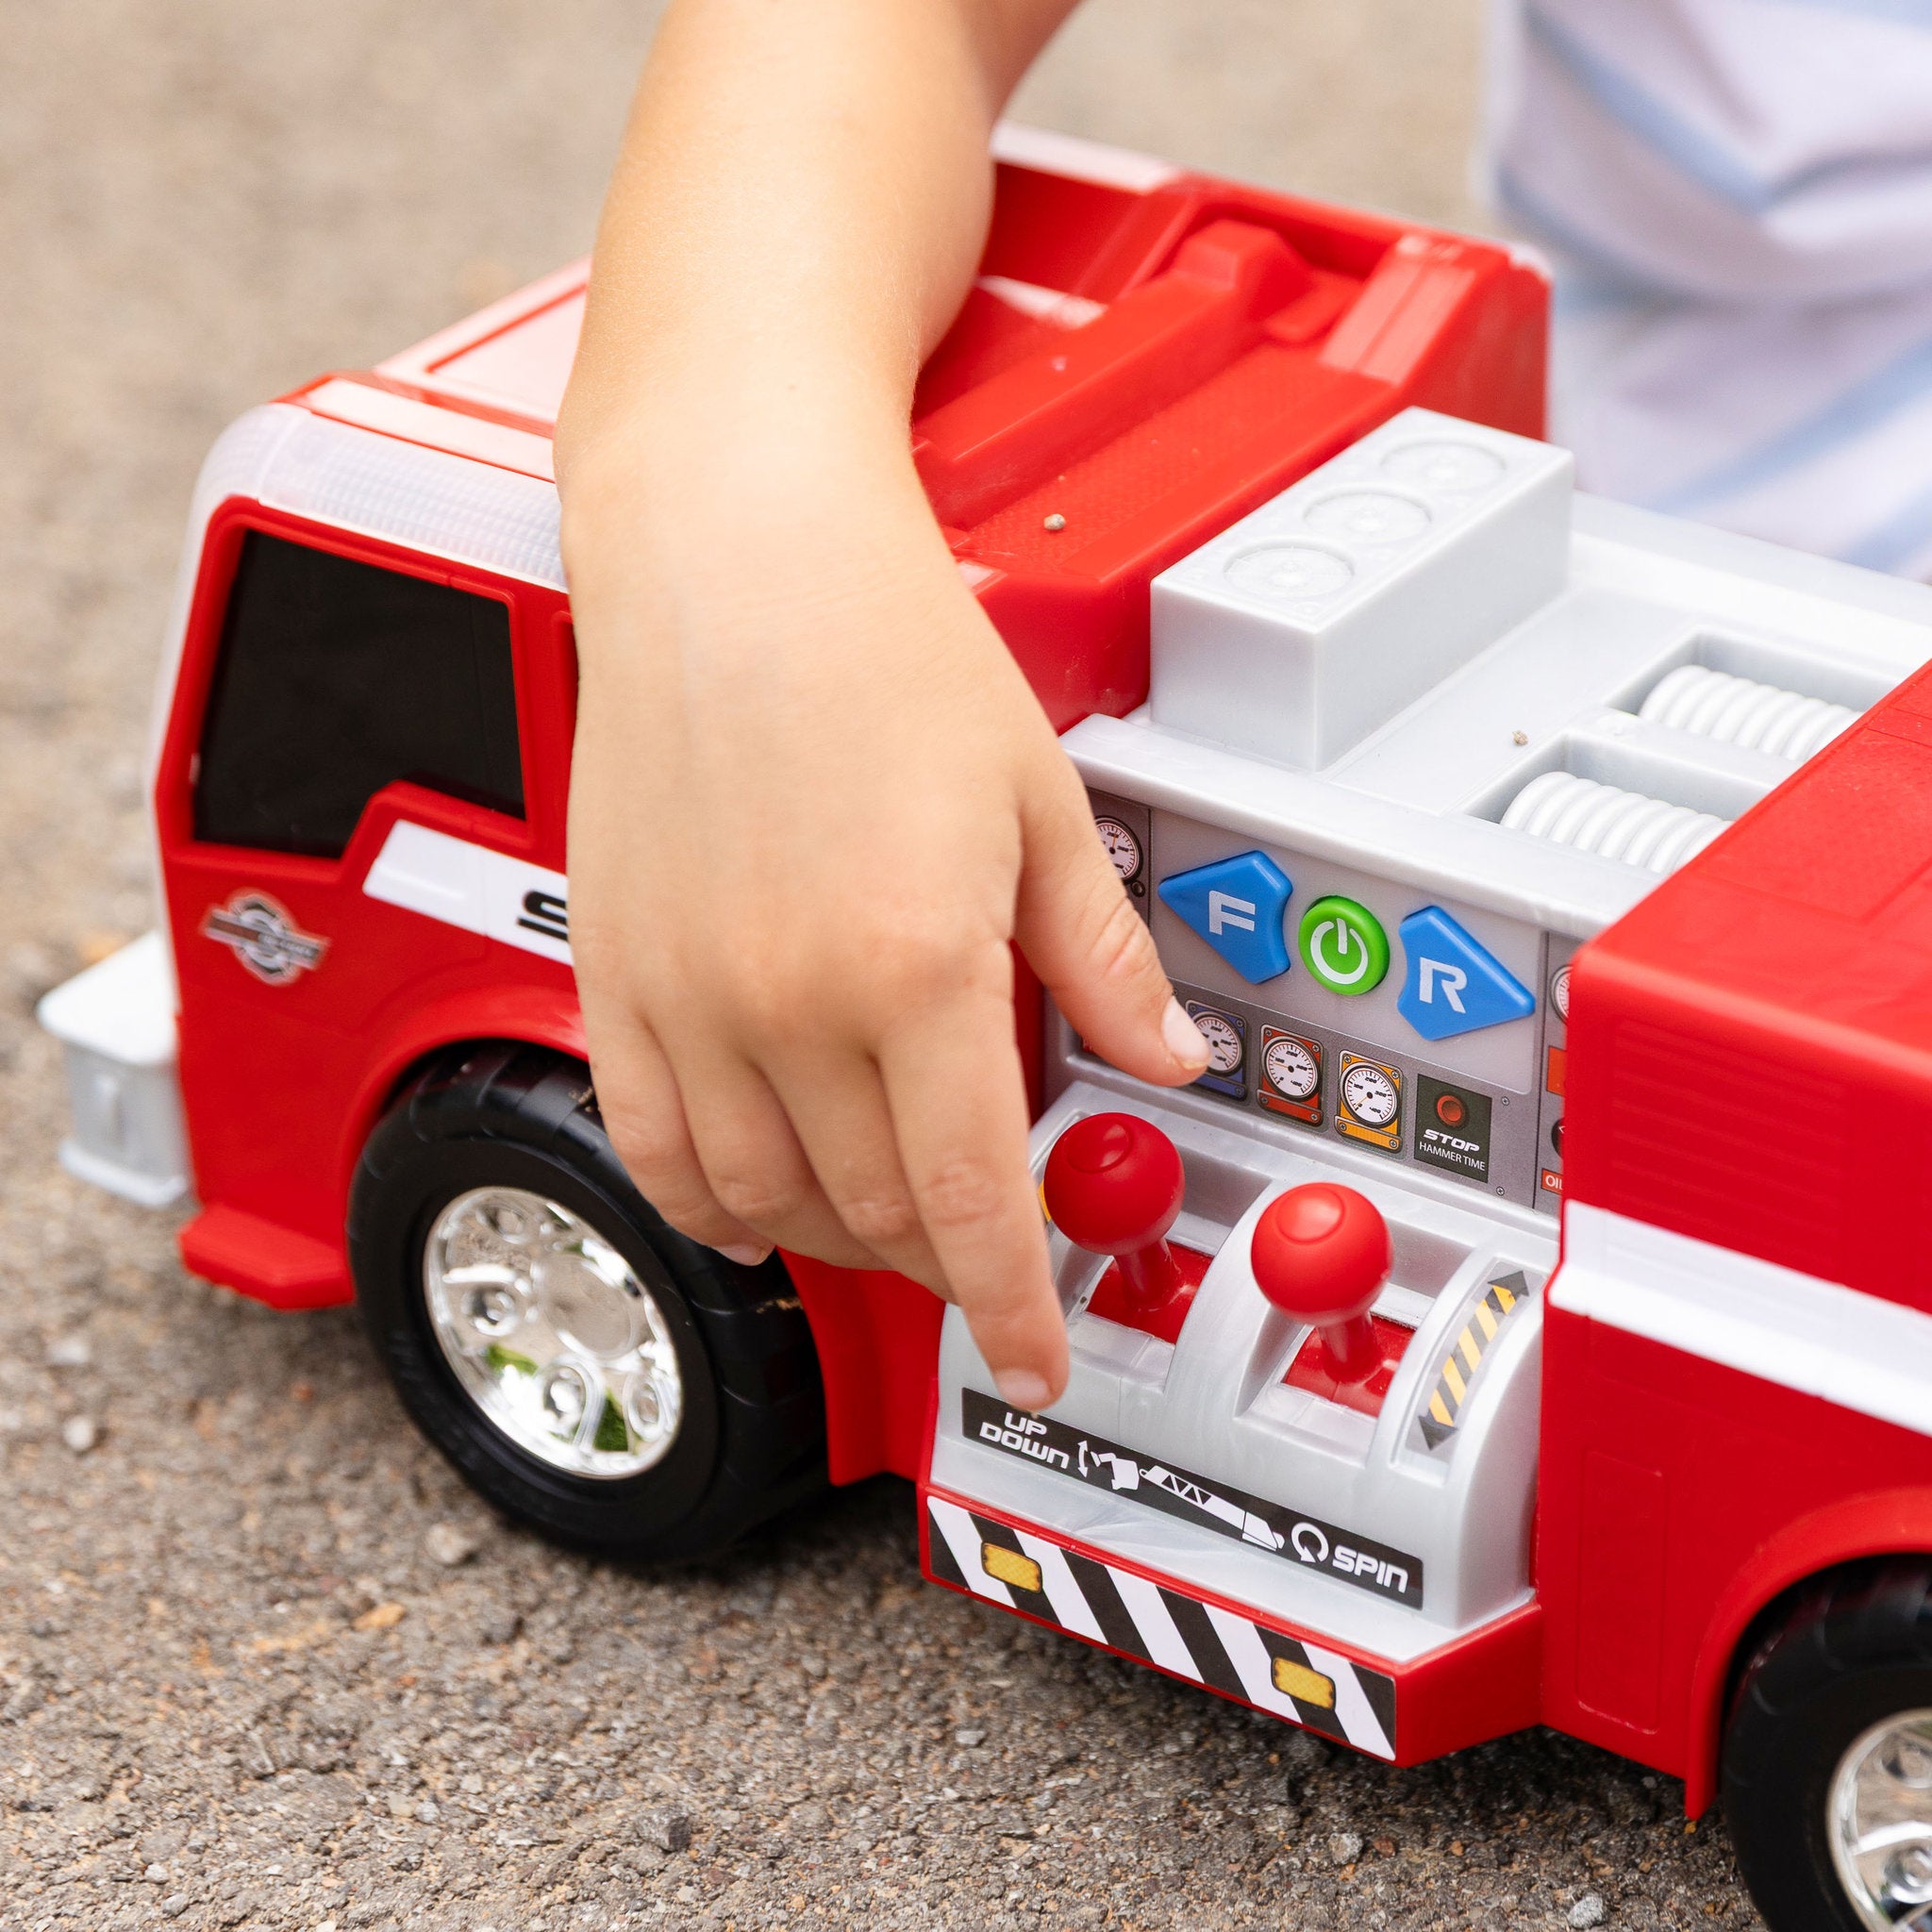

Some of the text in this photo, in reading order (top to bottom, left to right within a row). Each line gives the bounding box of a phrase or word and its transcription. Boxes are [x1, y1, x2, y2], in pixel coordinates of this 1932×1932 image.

[1208, 890, 1257, 936] F
[1419, 957, 1468, 1014] R
[1419, 1141, 1486, 1172] HAMMER TIME
[1424, 1128, 1480, 1152] STOP
[979, 1422, 1070, 1470] DOWN
[1004, 1411, 1047, 1436] UP
[1332, 1544, 1409, 1594] SPIN
